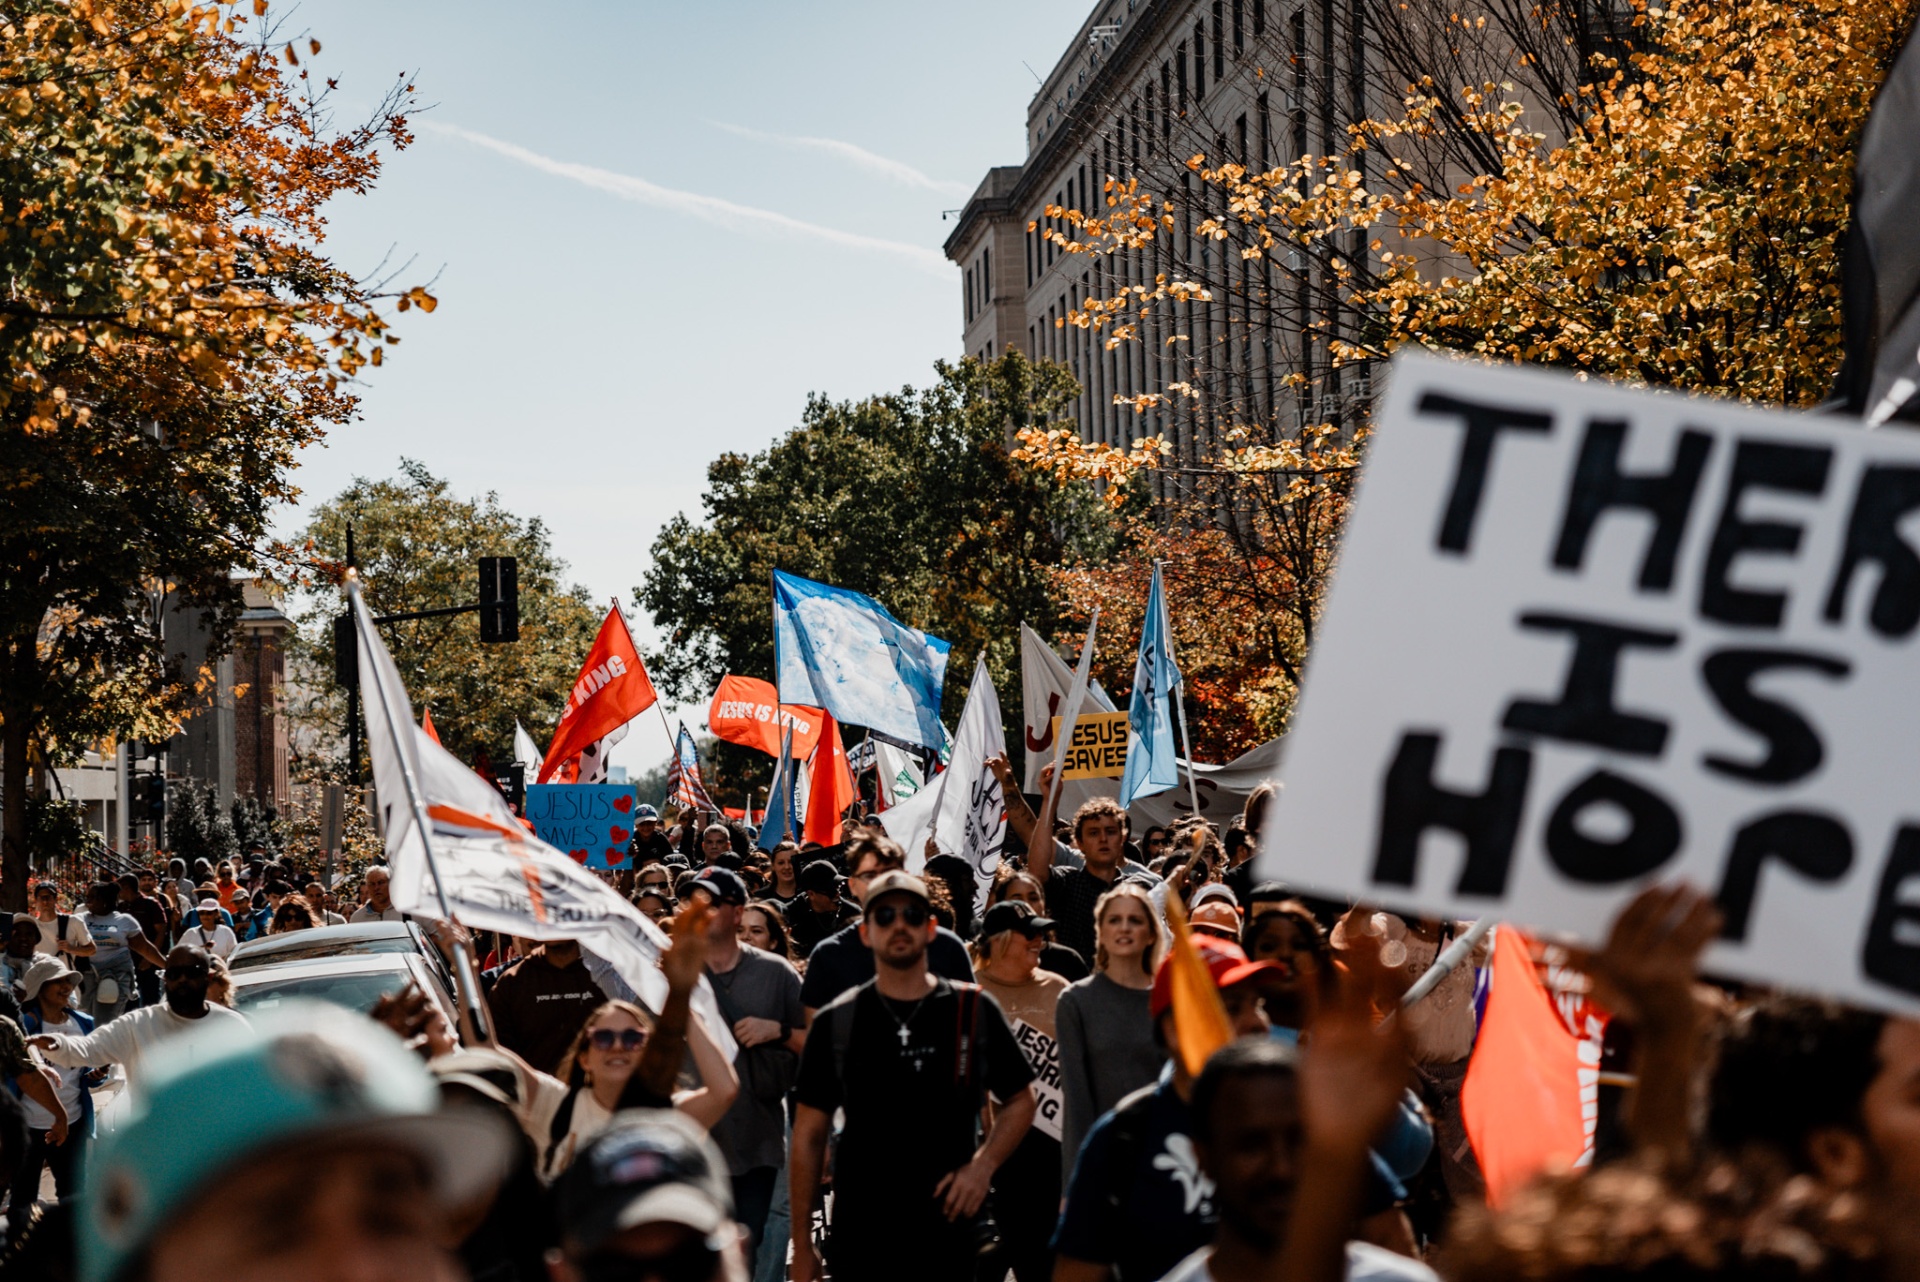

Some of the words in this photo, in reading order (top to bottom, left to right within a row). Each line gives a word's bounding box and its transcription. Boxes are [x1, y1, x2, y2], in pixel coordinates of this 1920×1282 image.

[573, 655, 627, 706] KING
[1500, 611, 1852, 789] IS
[718, 701, 754, 719] JESUS
[754, 704, 772, 723] IS
[771, 709, 810, 735] KING
[1073, 720, 1127, 746] ESUS
[1063, 745, 1127, 772] SAVES
[534, 791, 610, 820] JESUS
[541, 825, 598, 846] SAVES
[1014, 1022, 1060, 1062] JESU
